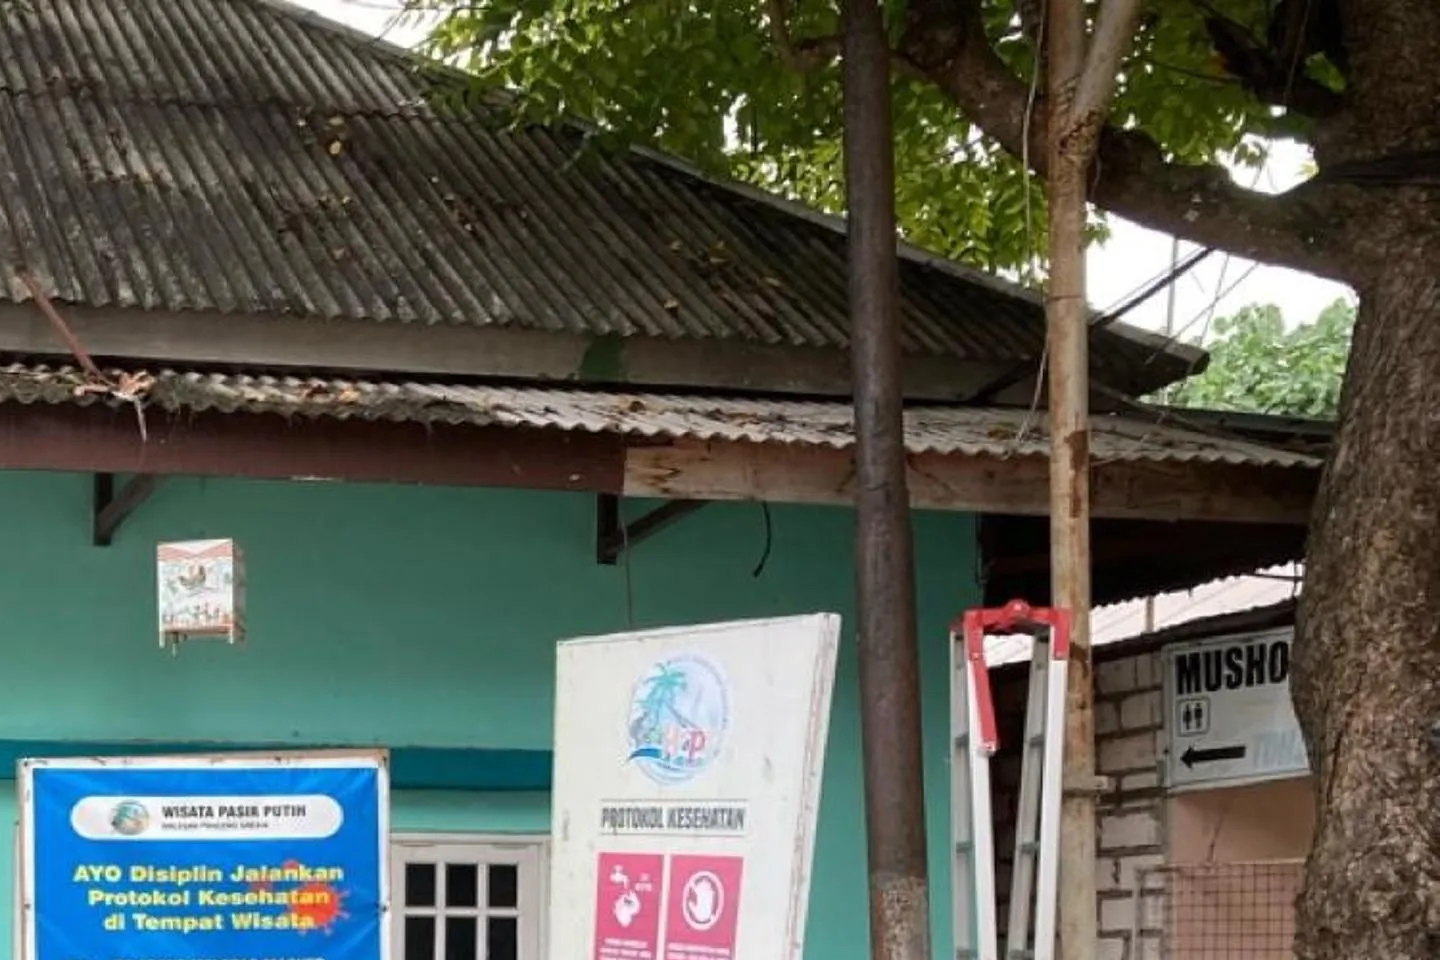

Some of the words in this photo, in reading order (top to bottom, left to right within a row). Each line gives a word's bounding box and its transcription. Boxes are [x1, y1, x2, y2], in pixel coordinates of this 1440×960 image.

[1176, 641, 1289, 695] MUSHO
[162, 805, 214, 818] WISATA
[218, 805, 260, 818] PASIR
[264, 804, 306, 817] PUTIH
[601, 806, 663, 829] PROTOKOL
[667, 807, 746, 831] KESEHATAN
[73, 865, 122, 882] AYO
[130, 864, 223, 886] Disiplin
[230, 864, 344, 882] Jalankan
[88, 889, 190, 906] Protokol
[198, 888, 330, 906] Kesehatan
[104, 912, 125, 931] di
[132, 912, 223, 935] Tempat
[231, 912, 316, 931] Wisata
